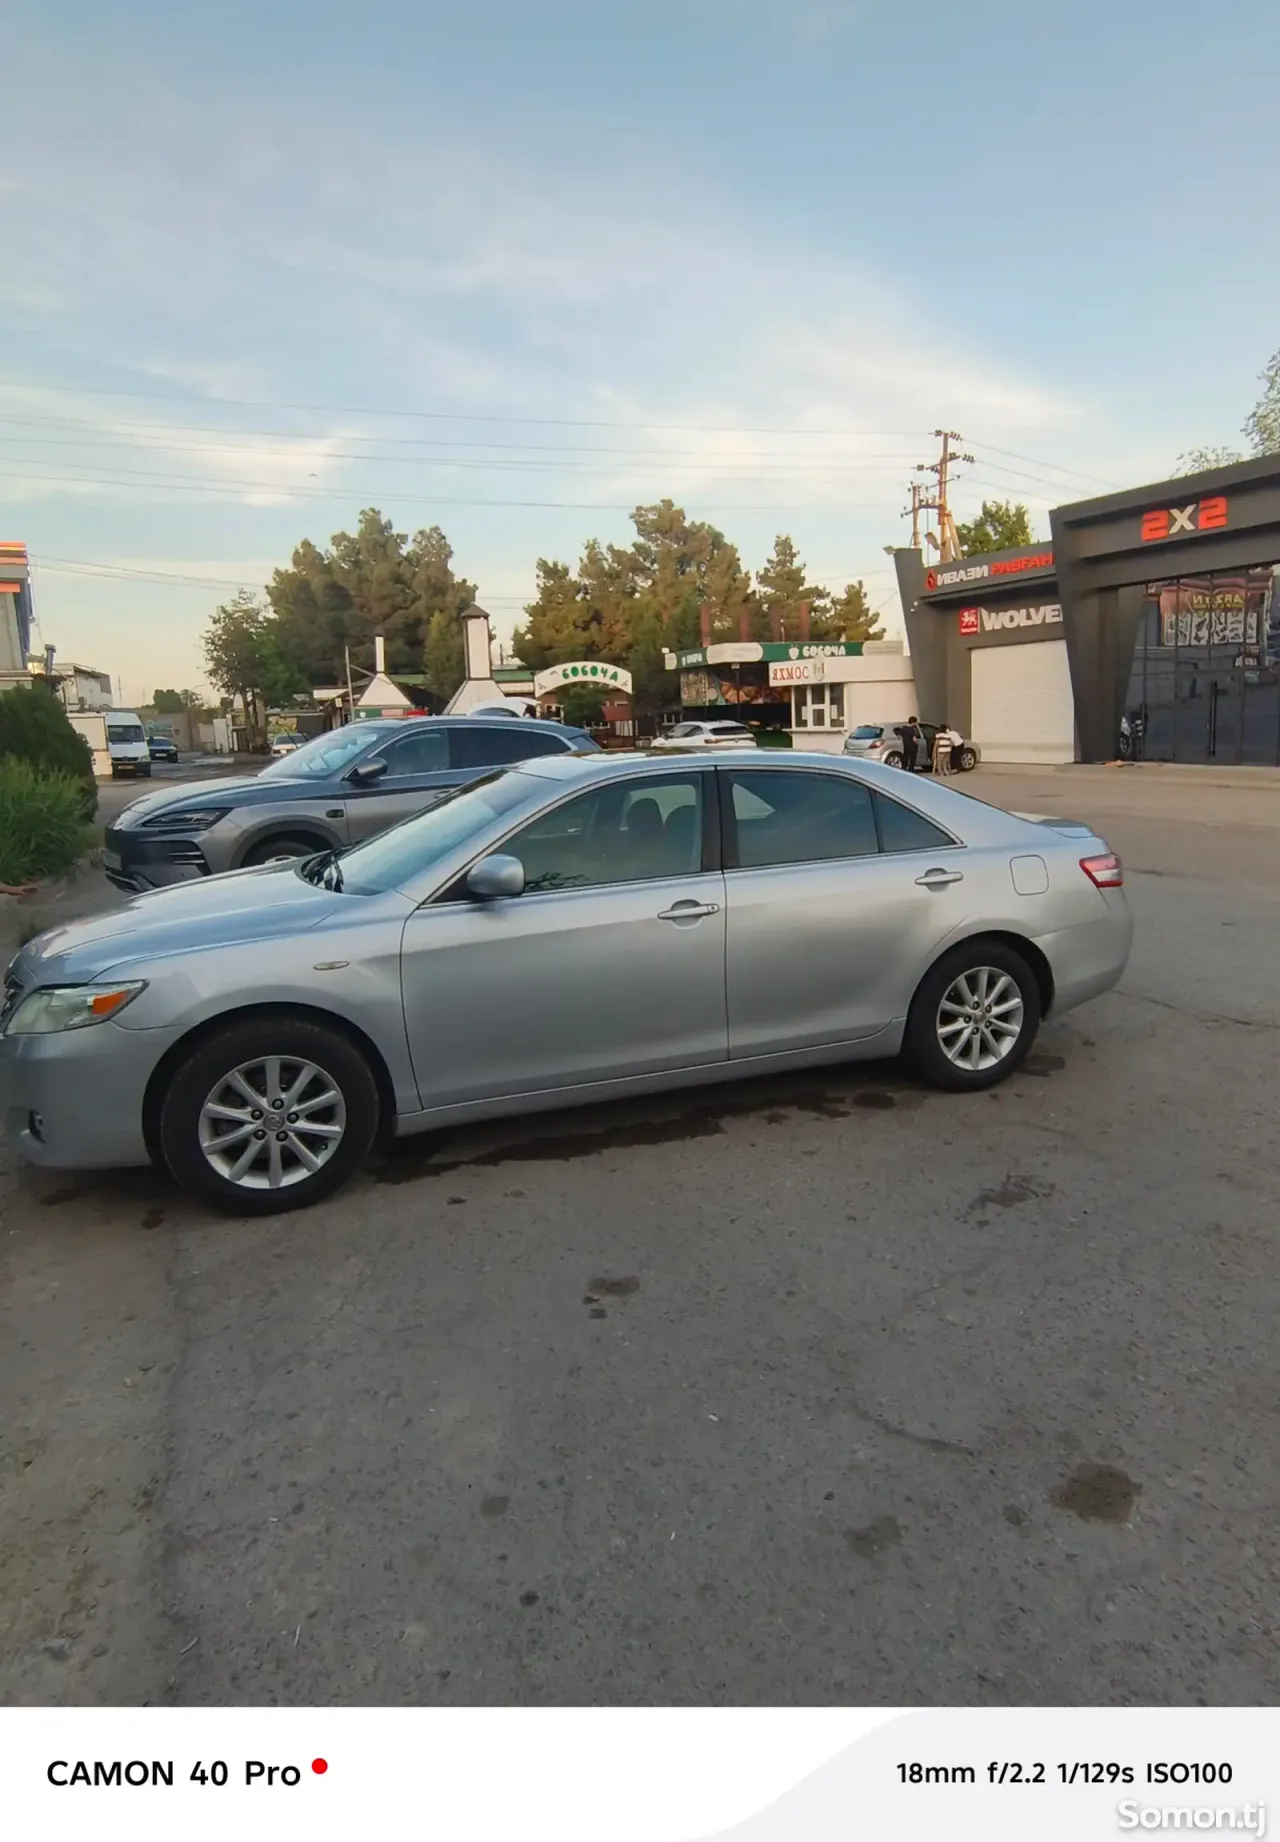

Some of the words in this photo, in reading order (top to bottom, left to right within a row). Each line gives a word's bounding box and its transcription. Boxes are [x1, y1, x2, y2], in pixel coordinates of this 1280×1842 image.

[937, 565, 988, 586] ИВАЗИ
[980, 604, 1063, 631] WOLVE
[772, 666, 809, 681] ЯХМОС
